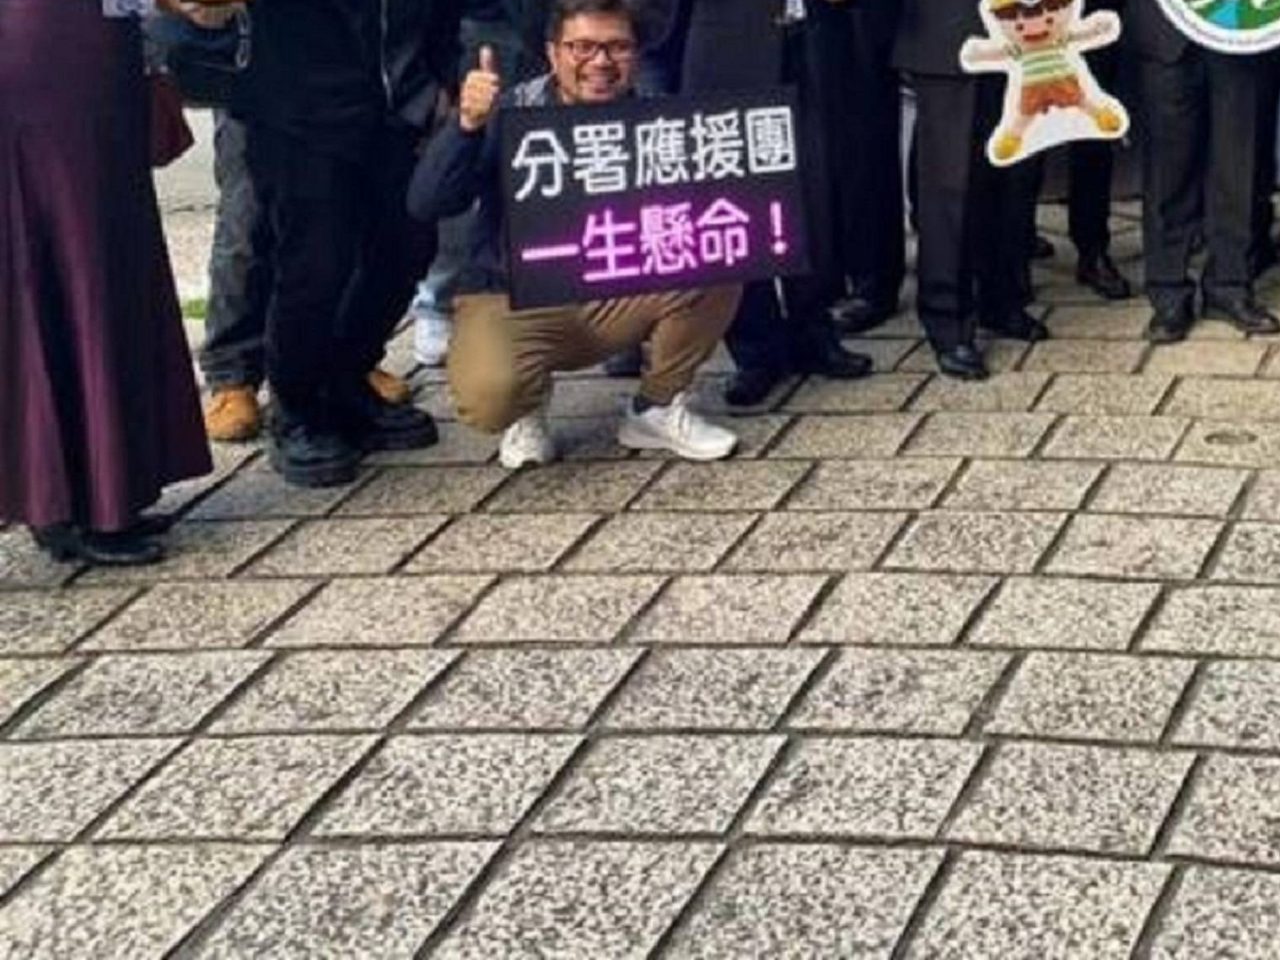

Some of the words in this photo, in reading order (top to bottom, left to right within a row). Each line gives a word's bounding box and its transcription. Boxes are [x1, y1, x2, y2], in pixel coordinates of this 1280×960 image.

[511, 105, 797, 202] 分署應援團
[521, 197, 788, 282] 一生懸命！
